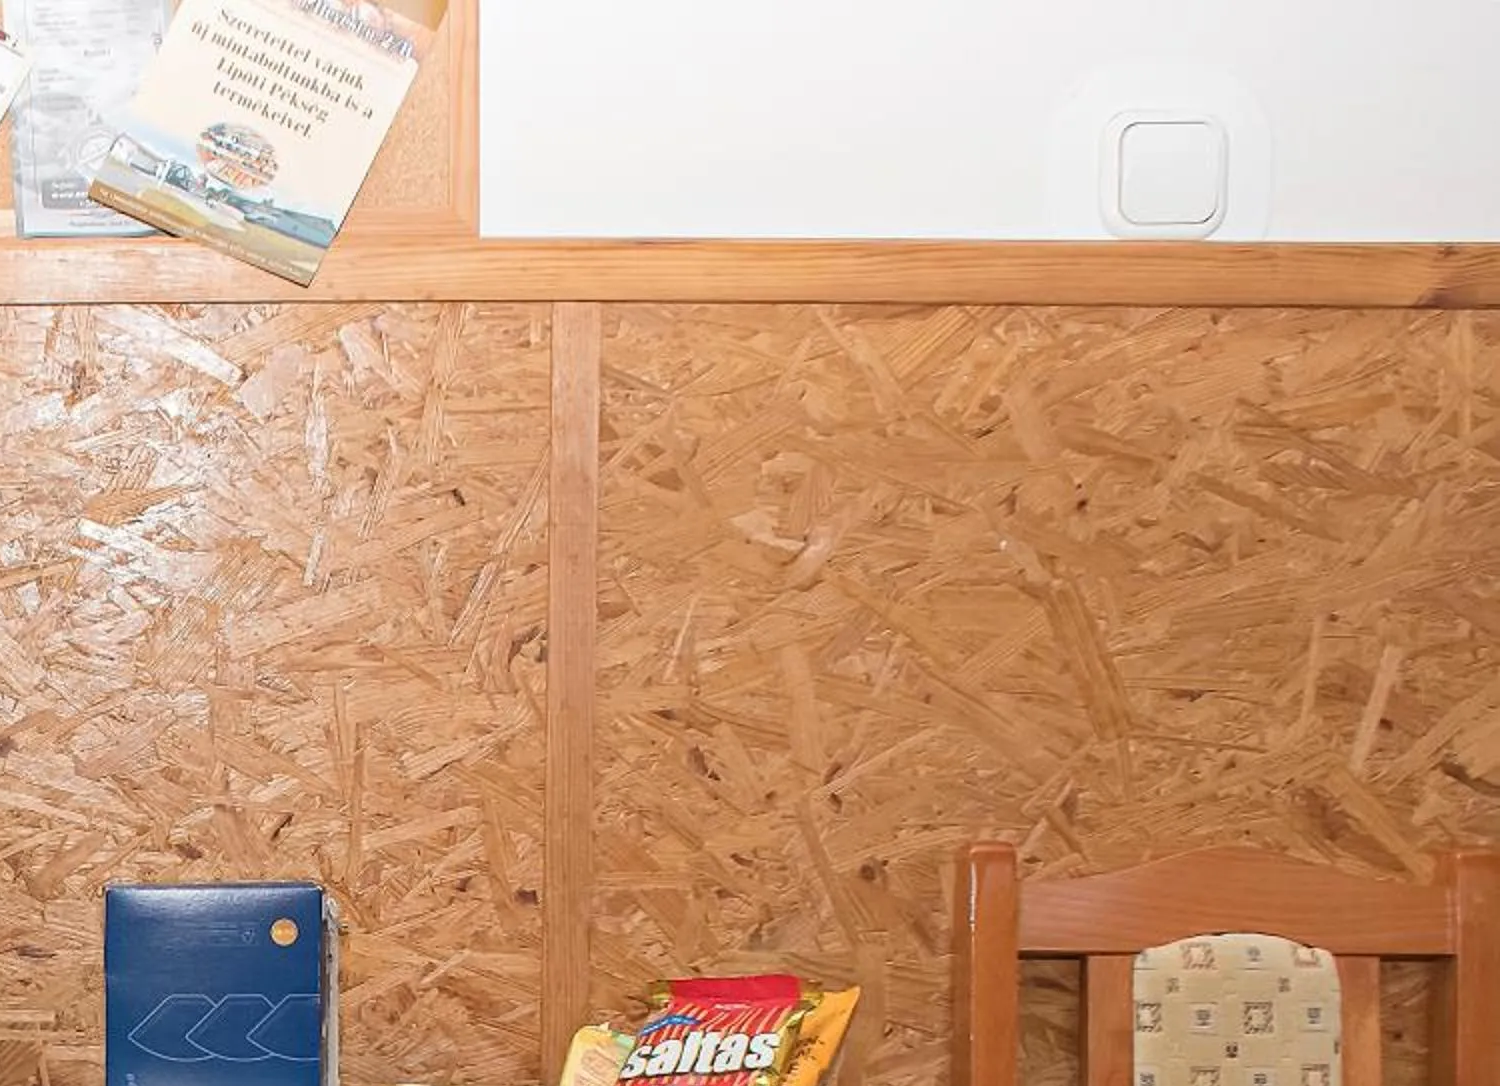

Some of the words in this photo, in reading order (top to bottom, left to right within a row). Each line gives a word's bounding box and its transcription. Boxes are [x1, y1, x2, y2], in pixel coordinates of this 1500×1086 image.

[217, 9, 311, 63] Szeretettel
[211, 30, 341, 102] mintaboltunkba
[344, 95, 359, 111] is
[362, 108, 373, 119] a
[619, 1030, 781, 1080] saltas
